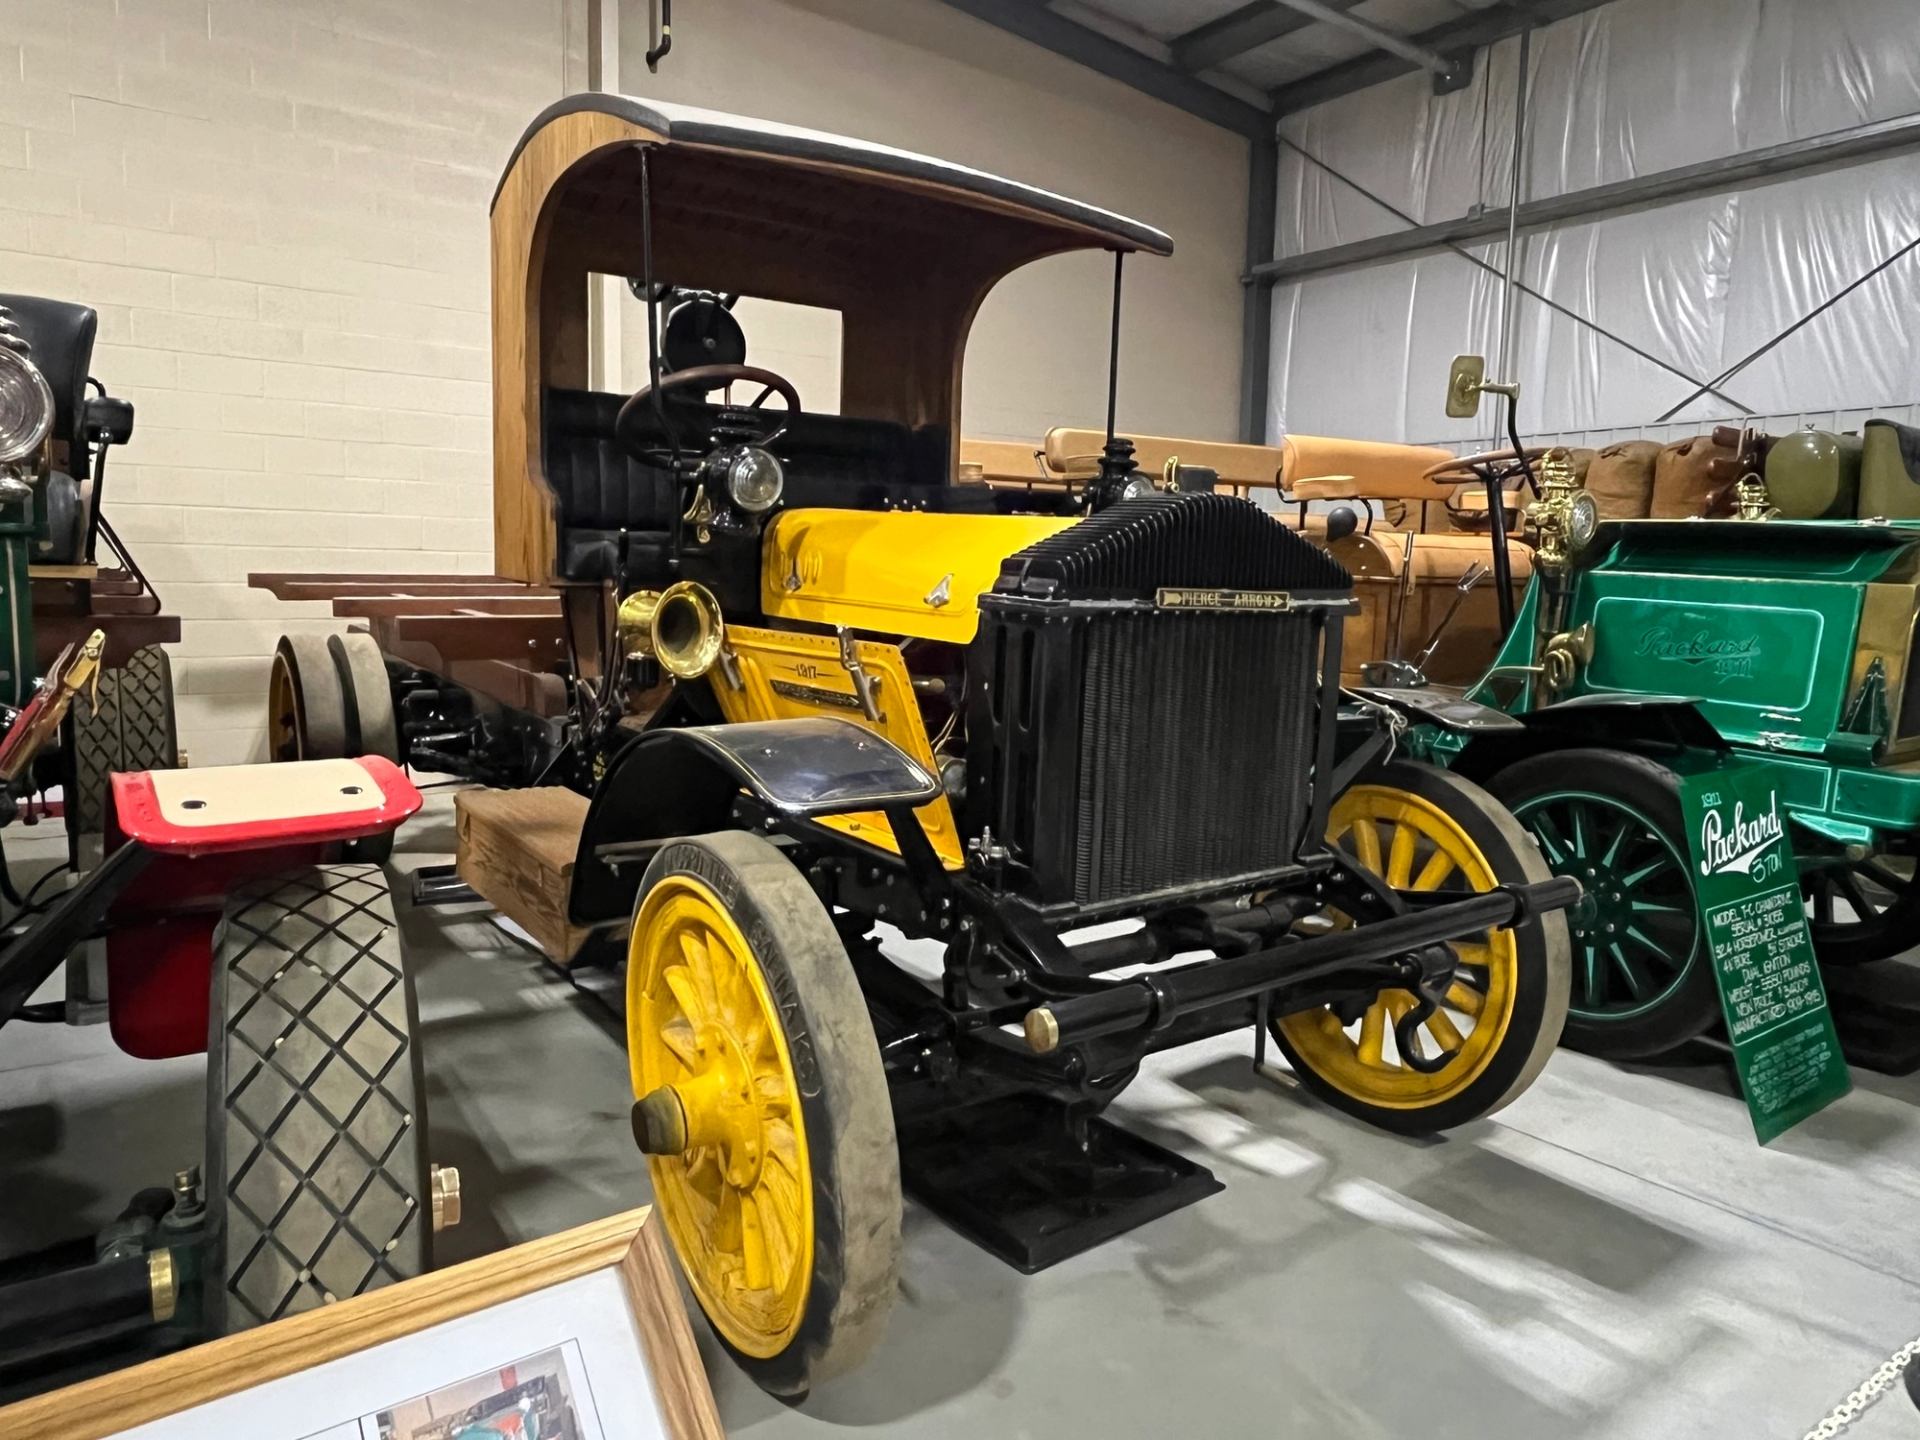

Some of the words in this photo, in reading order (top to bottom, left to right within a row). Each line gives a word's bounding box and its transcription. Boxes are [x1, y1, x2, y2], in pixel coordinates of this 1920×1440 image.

[1182, 592, 1221, 606] PIERCE
[1234, 594, 1272, 607] ARROW
[1634, 626, 1761, 657] Packard
[1701, 791, 1722, 808] 1911
[1701, 790, 1783, 876] Packard
[1713, 908, 1741, 927] MODEL
